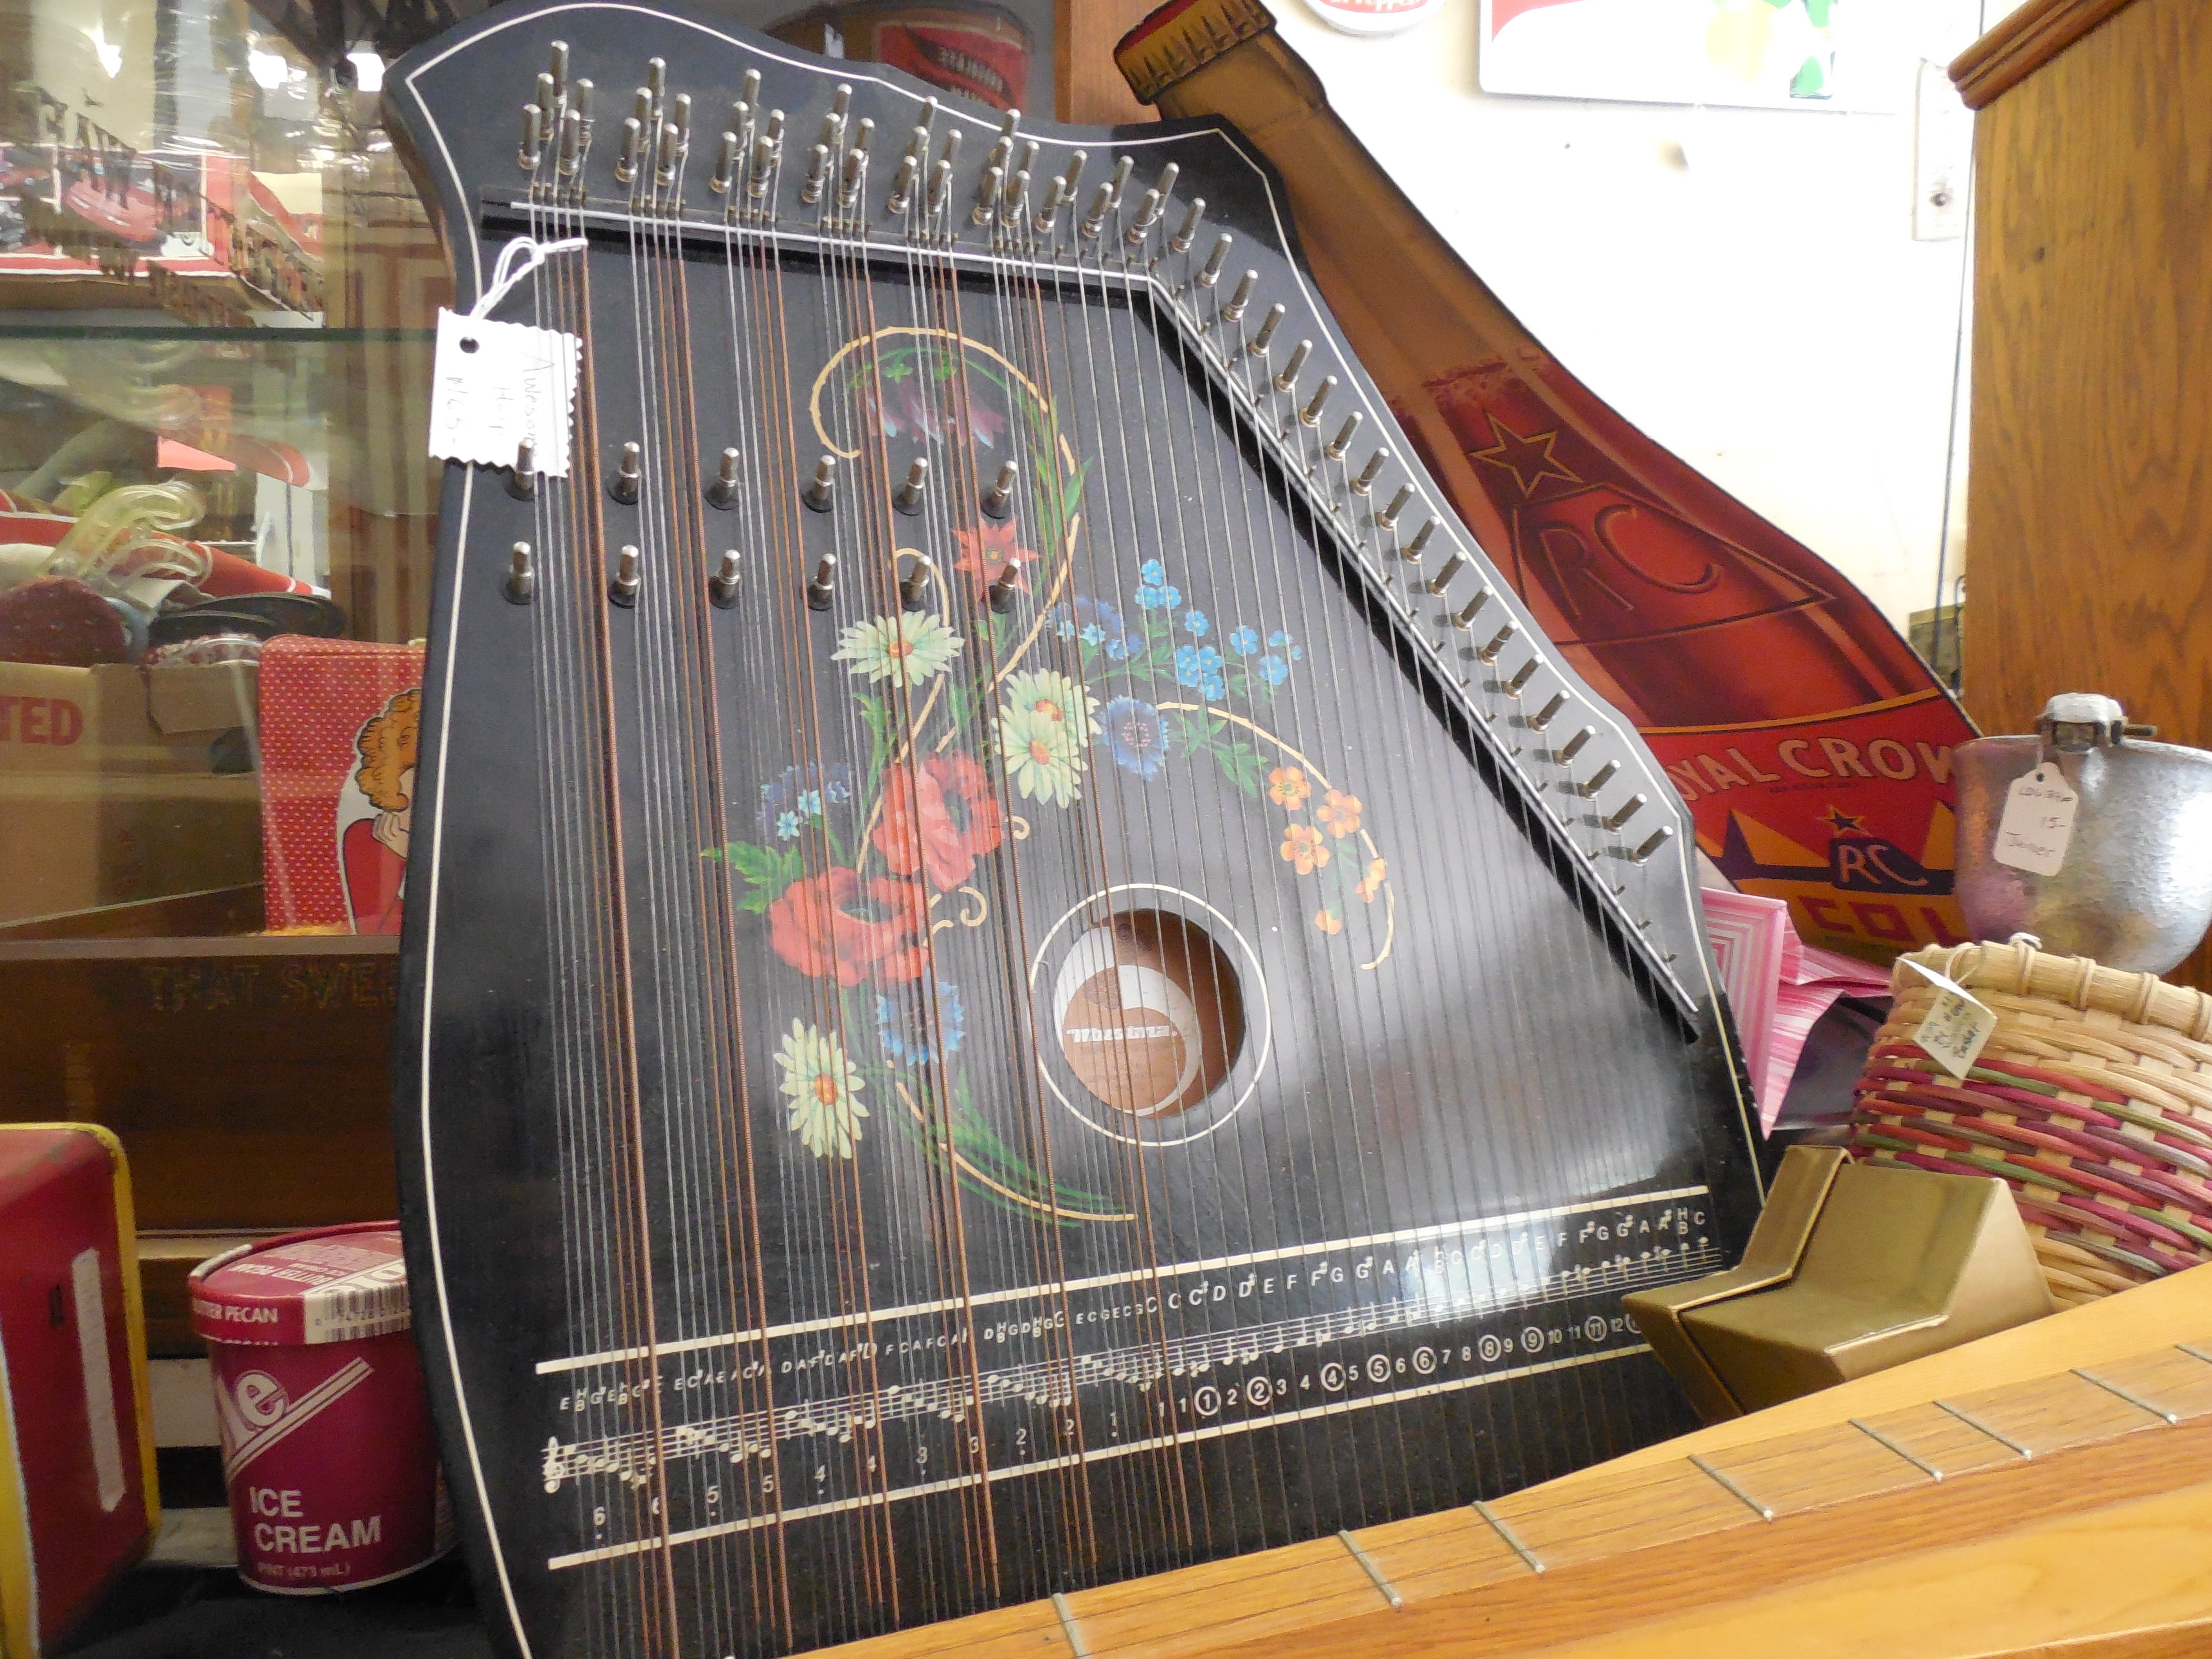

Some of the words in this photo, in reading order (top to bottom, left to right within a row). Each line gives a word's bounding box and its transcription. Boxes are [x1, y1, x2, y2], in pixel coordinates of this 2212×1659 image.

[1667, 748, 1781, 801] OYAL
[1778, 737, 1953, 783] CROW
[1837, 844, 1929, 887] RC
[1798, 895, 1973, 947] COL
[225, 1305, 279, 1324] PECAN
[1227, 1388, 1237, 1405] 2
[1276, 1378, 1287, 1395] 3
[1348, 1365, 1359, 1381] 5
[1395, 1357, 1406, 1373] 6
[1441, 1349, 1452, 1364] 7
[1461, 1345, 1472, 1362] 8
[1503, 1337, 1514, 1353] 9
[249, 1485, 304, 1518] ICE
[254, 1514, 382, 1554] CREAM
